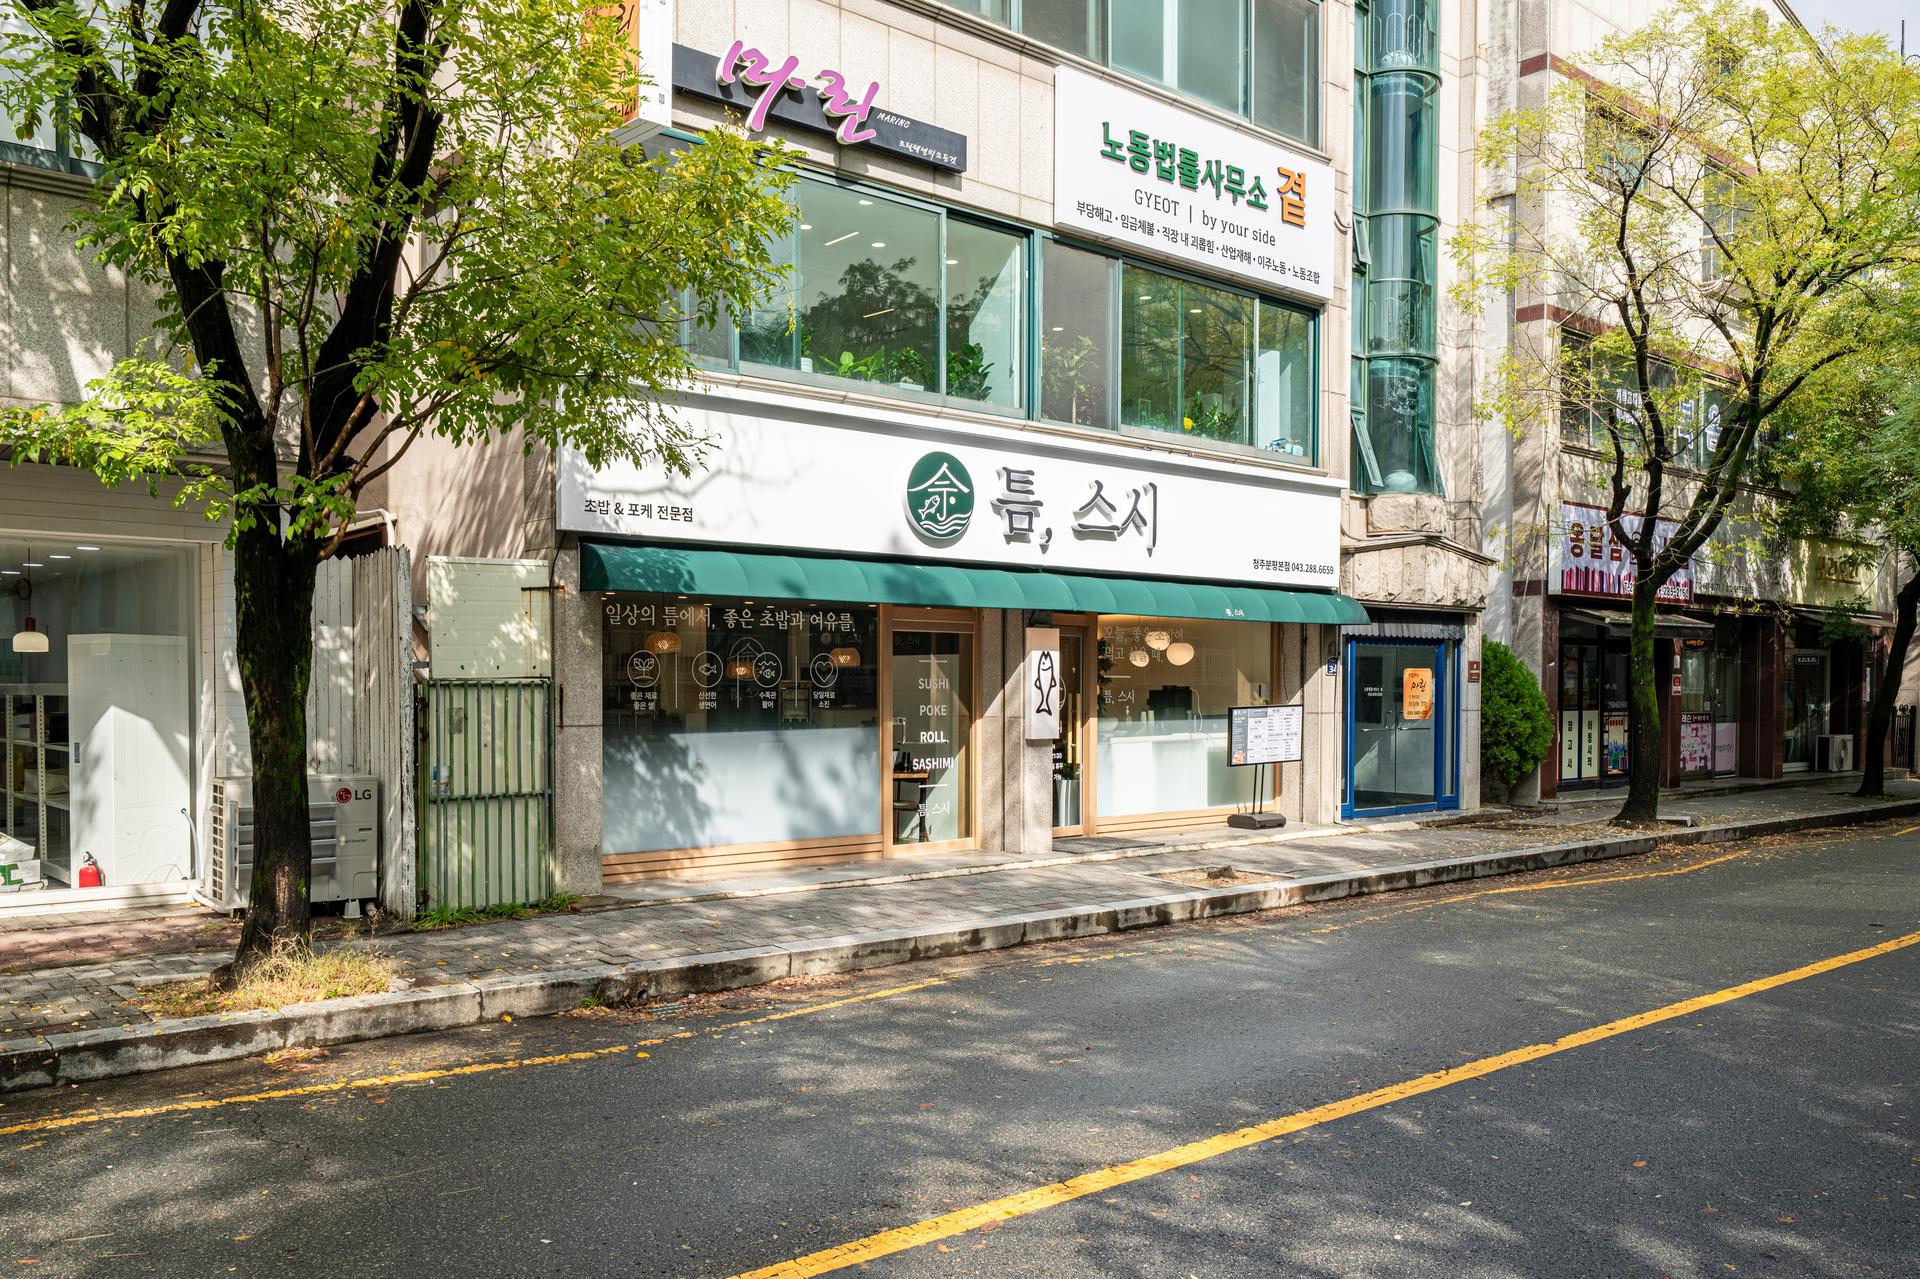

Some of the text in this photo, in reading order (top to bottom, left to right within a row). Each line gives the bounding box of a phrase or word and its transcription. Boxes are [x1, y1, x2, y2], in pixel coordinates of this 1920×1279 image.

[1100, 121, 1307, 229] 노동법률사무소 곁
[1134, 189, 1276, 246] GYEOT by your side
[1180, 232, 1189, 247] 내
[584, 498, 694, 522] 초밥 & 포케 전문점
[1076, 479, 1158, 549] 스시
[1252, 558, 1334, 575] 청주분평본점 043.288.6659
[606, 603, 856, 632] 일상의 틈에서, 좋은 초밥과 여유를.
[1103, 643, 1125, 661] 먹고
[918, 678, 949, 690] SUSHI
[699, 691, 717, 700] 신선한
[1118, 689, 1135, 703] 스시
[699, 701, 717, 710] 생연어
[819, 701, 830, 709] 소진
[920, 704, 947, 716] POKE
[912, 757, 954, 771] SASHIMI
[354, 789, 372, 801] LG
[931, 801, 950, 815] 스시
